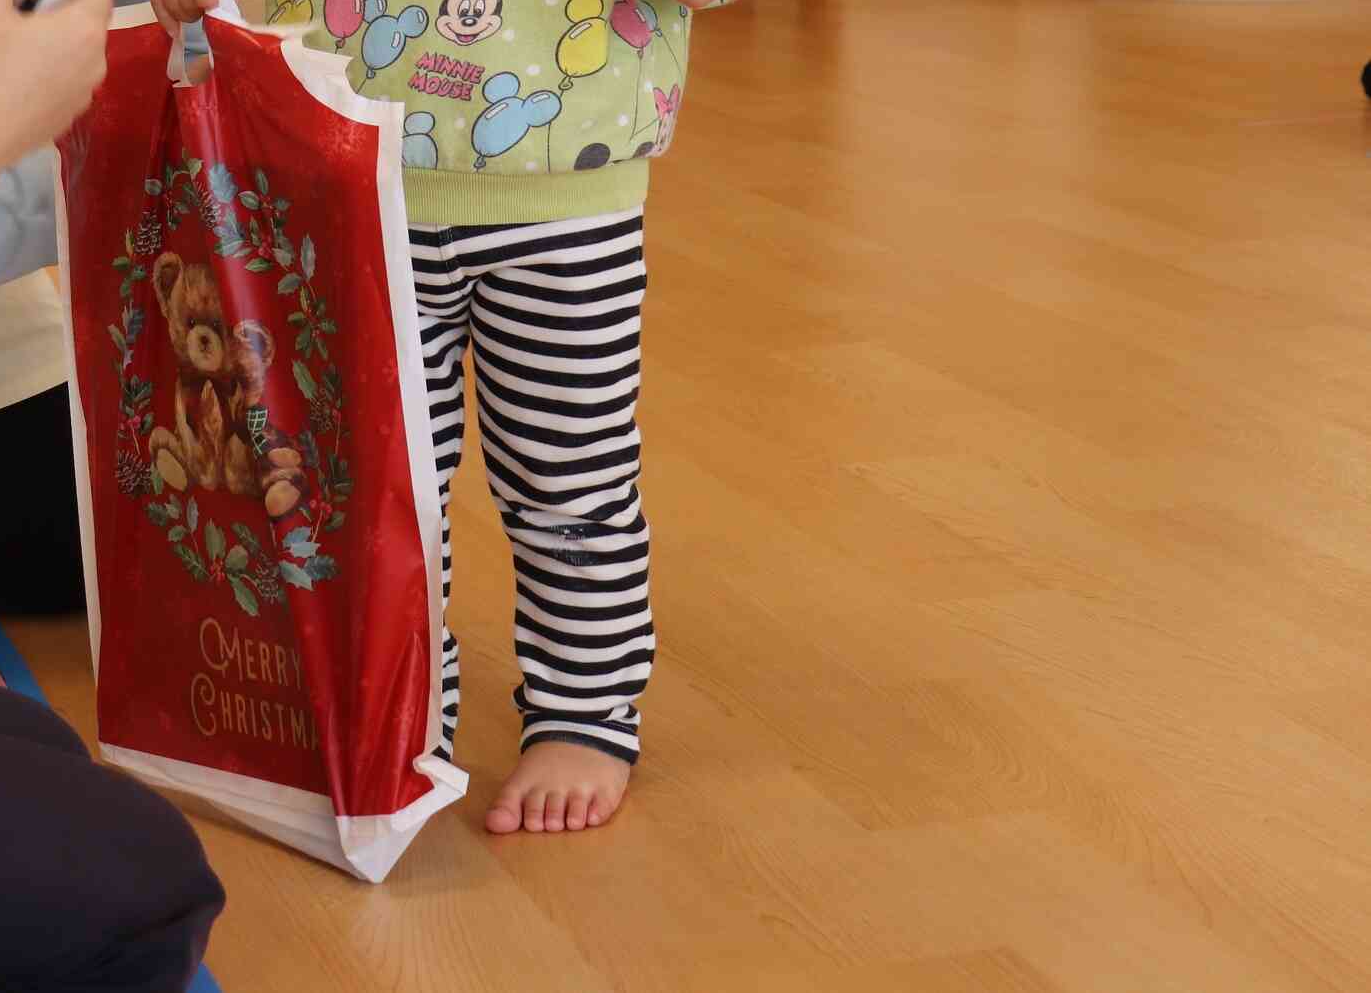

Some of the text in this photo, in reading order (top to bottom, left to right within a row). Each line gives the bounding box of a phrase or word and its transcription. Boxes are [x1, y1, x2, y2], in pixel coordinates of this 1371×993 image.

[415, 51, 486, 85] MINNIE
[407, 70, 474, 102] MOUSE
[199, 617, 302, 690] MERRY
